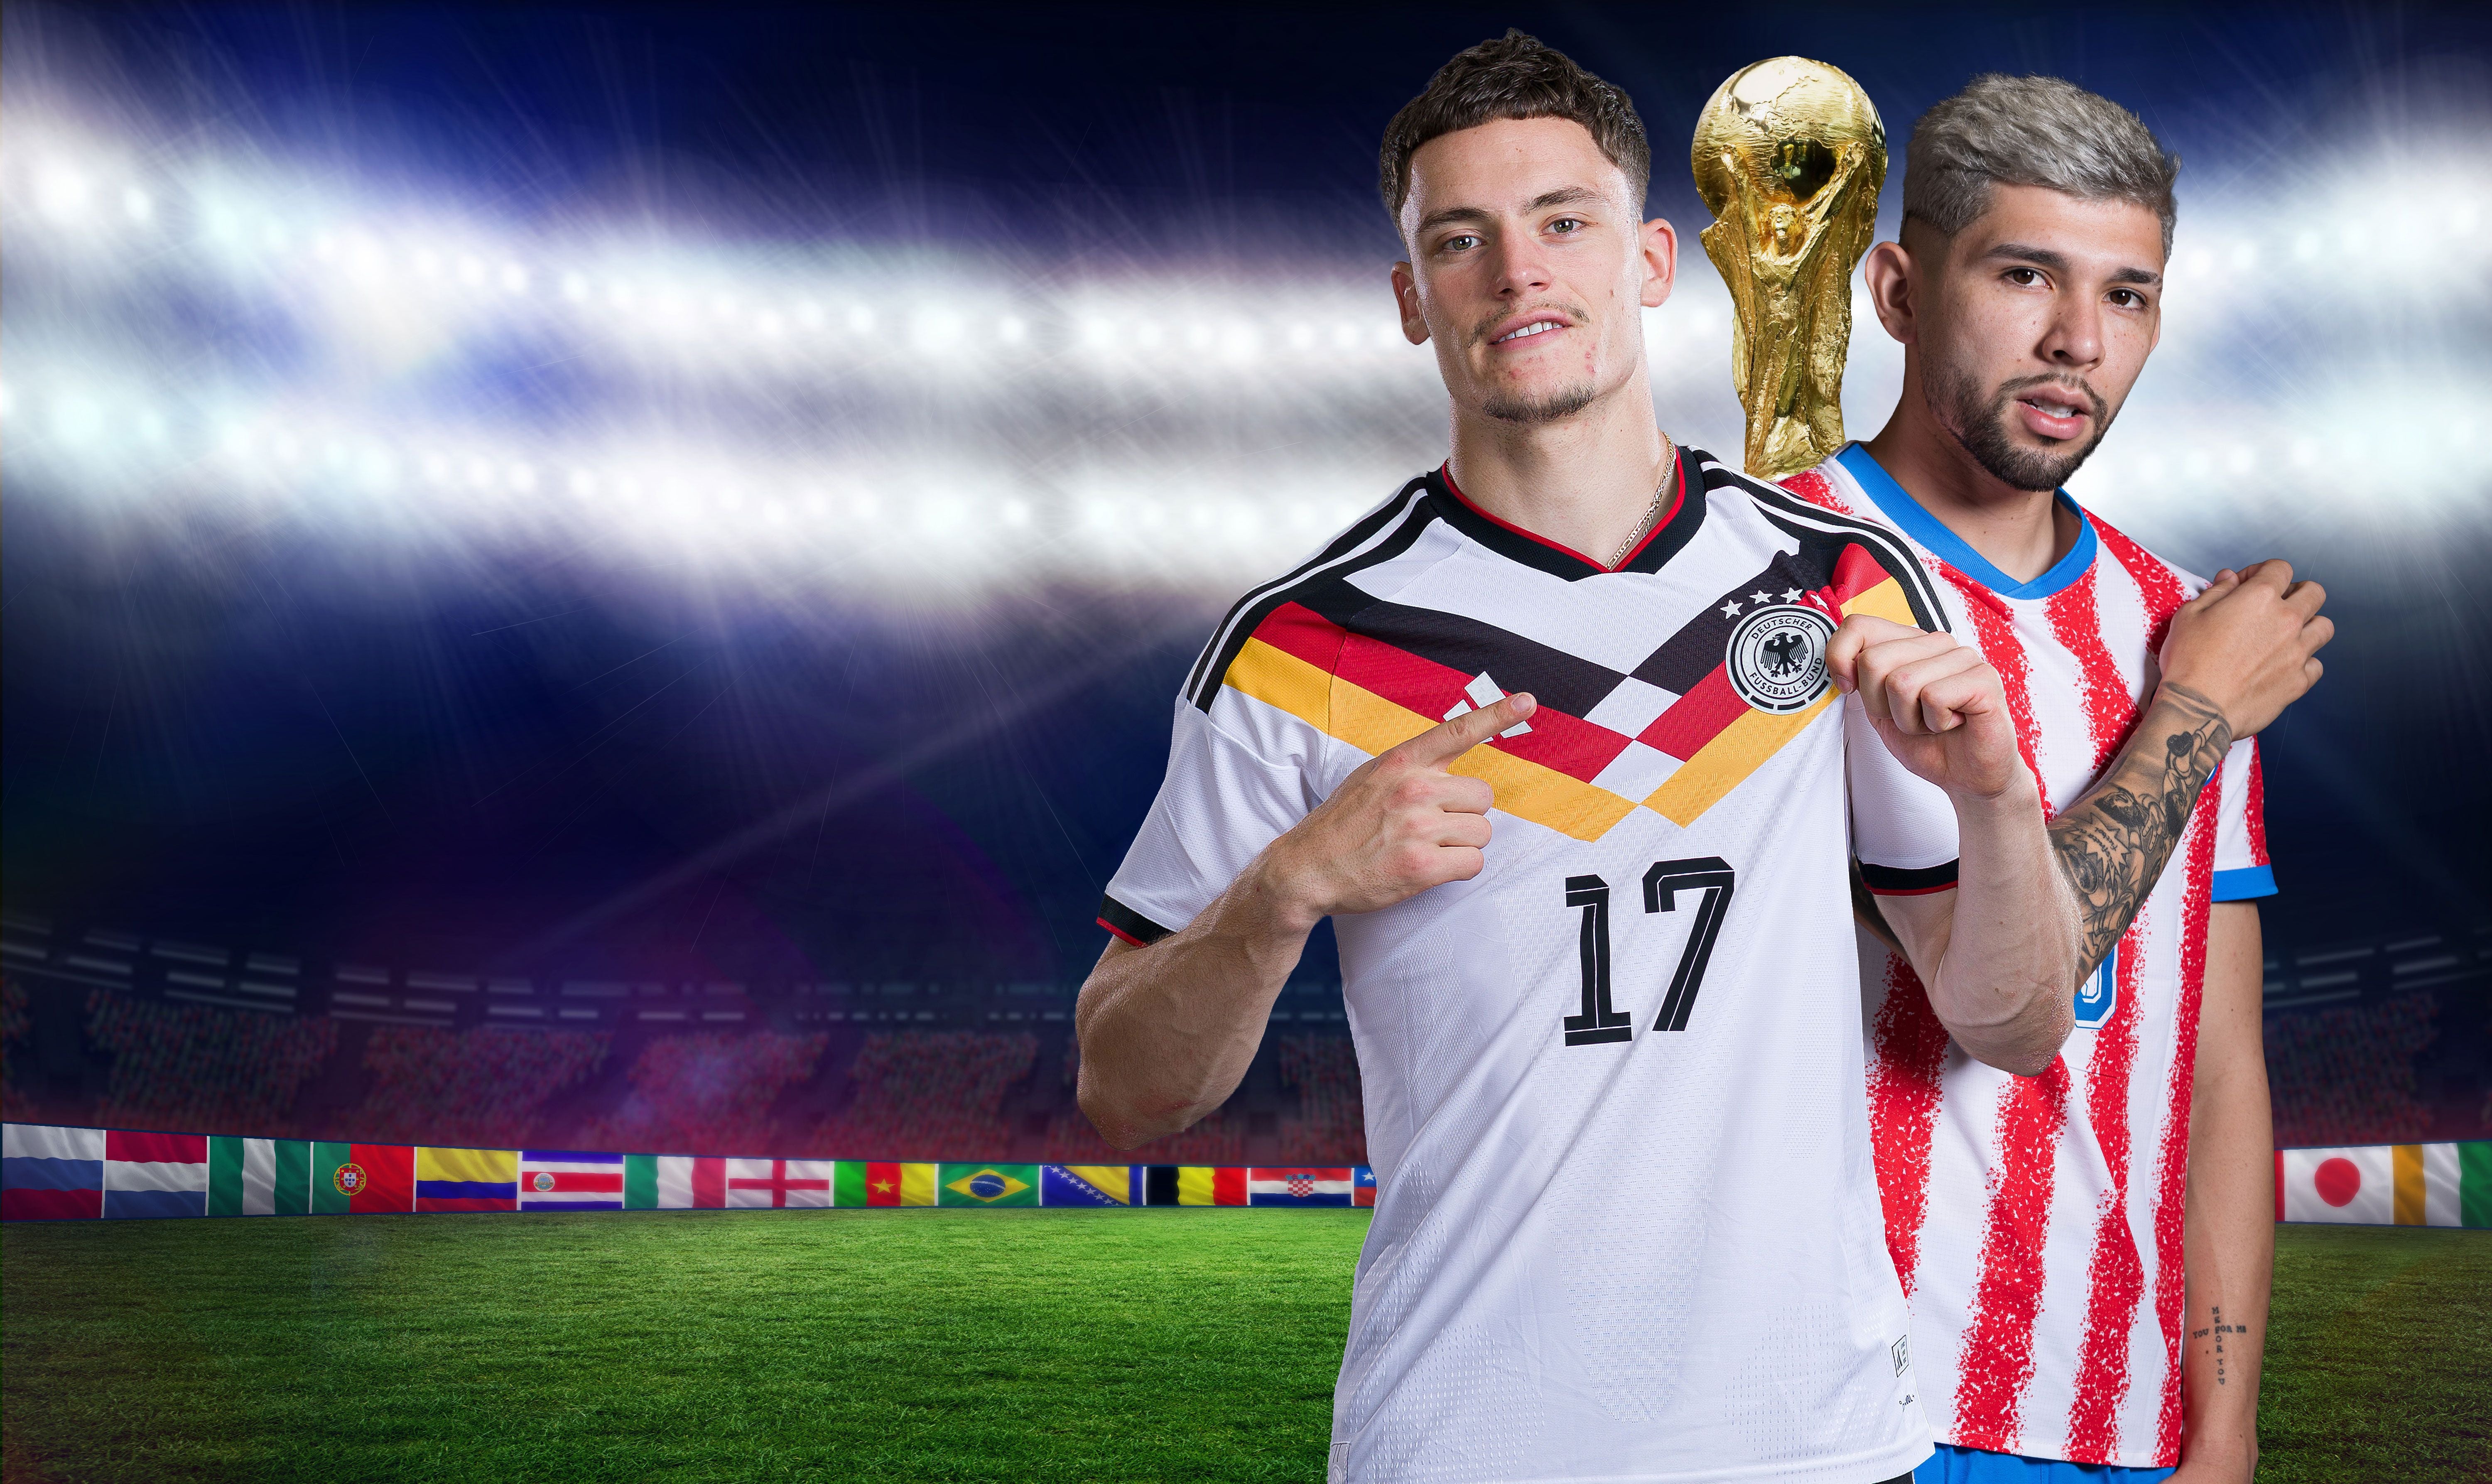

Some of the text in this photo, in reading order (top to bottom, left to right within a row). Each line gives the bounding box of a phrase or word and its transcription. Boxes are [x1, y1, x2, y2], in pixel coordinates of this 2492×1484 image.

[1751, 618, 1813, 640] DEUTSCHER
[1749, 657, 1822, 695] FUSSBALL-BUND
[1563, 856, 1735, 1047] 17
[2193, 1328, 2209, 1339] YOU
[2217, 1359, 2225, 1385] YOU
